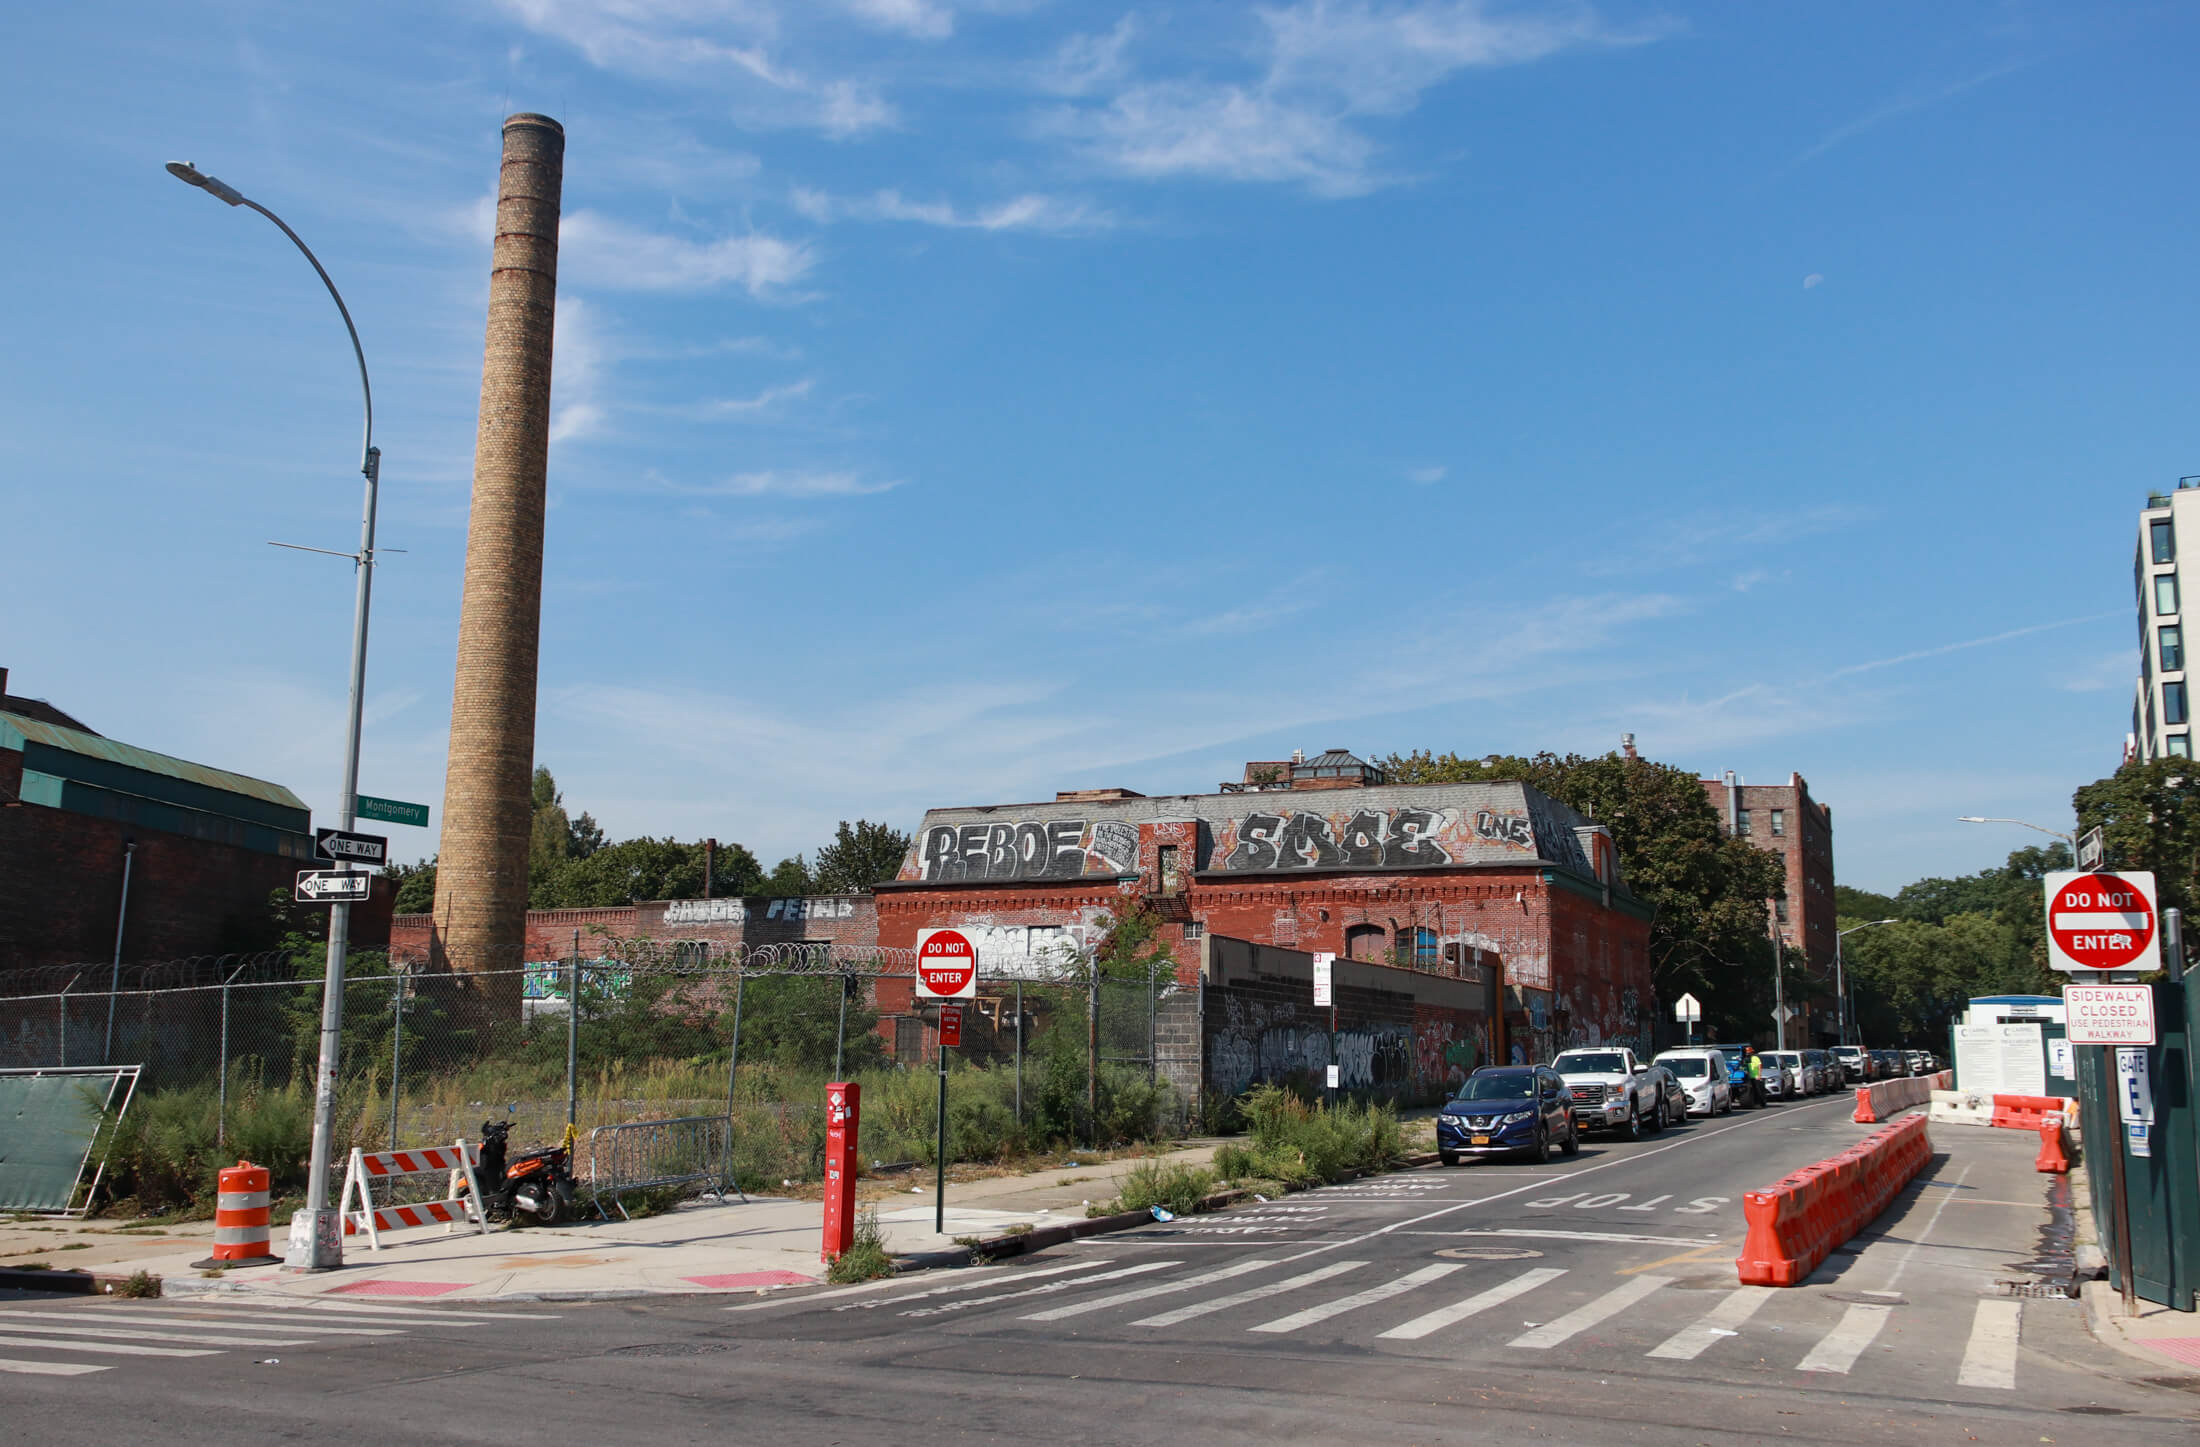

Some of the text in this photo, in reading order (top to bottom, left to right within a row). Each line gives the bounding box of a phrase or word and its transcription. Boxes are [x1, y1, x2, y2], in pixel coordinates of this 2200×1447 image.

[365, 799, 420, 819] Montgomery
[329, 839, 378, 856] ONE WAY
[305, 879, 363, 891] ONE WAY
[2065, 893, 2134, 907] DO NOT
[928, 943, 965, 953] DO NOT
[929, 973, 962, 983] ENTER
[2071, 991, 2144, 1002] SIDEWALK
[2080, 1005, 2137, 1016] CLOSED
[2071, 1019, 2149, 1028] USE PEDESTRIAN
[2087, 1030, 2133, 1039] WALKWAY
[2056, 1049, 2065, 1062] F
[2120, 1055, 2144, 1073] GATE
[2128, 1077, 2141, 1115] E
[1524, 1192, 1731, 1213] STOP
